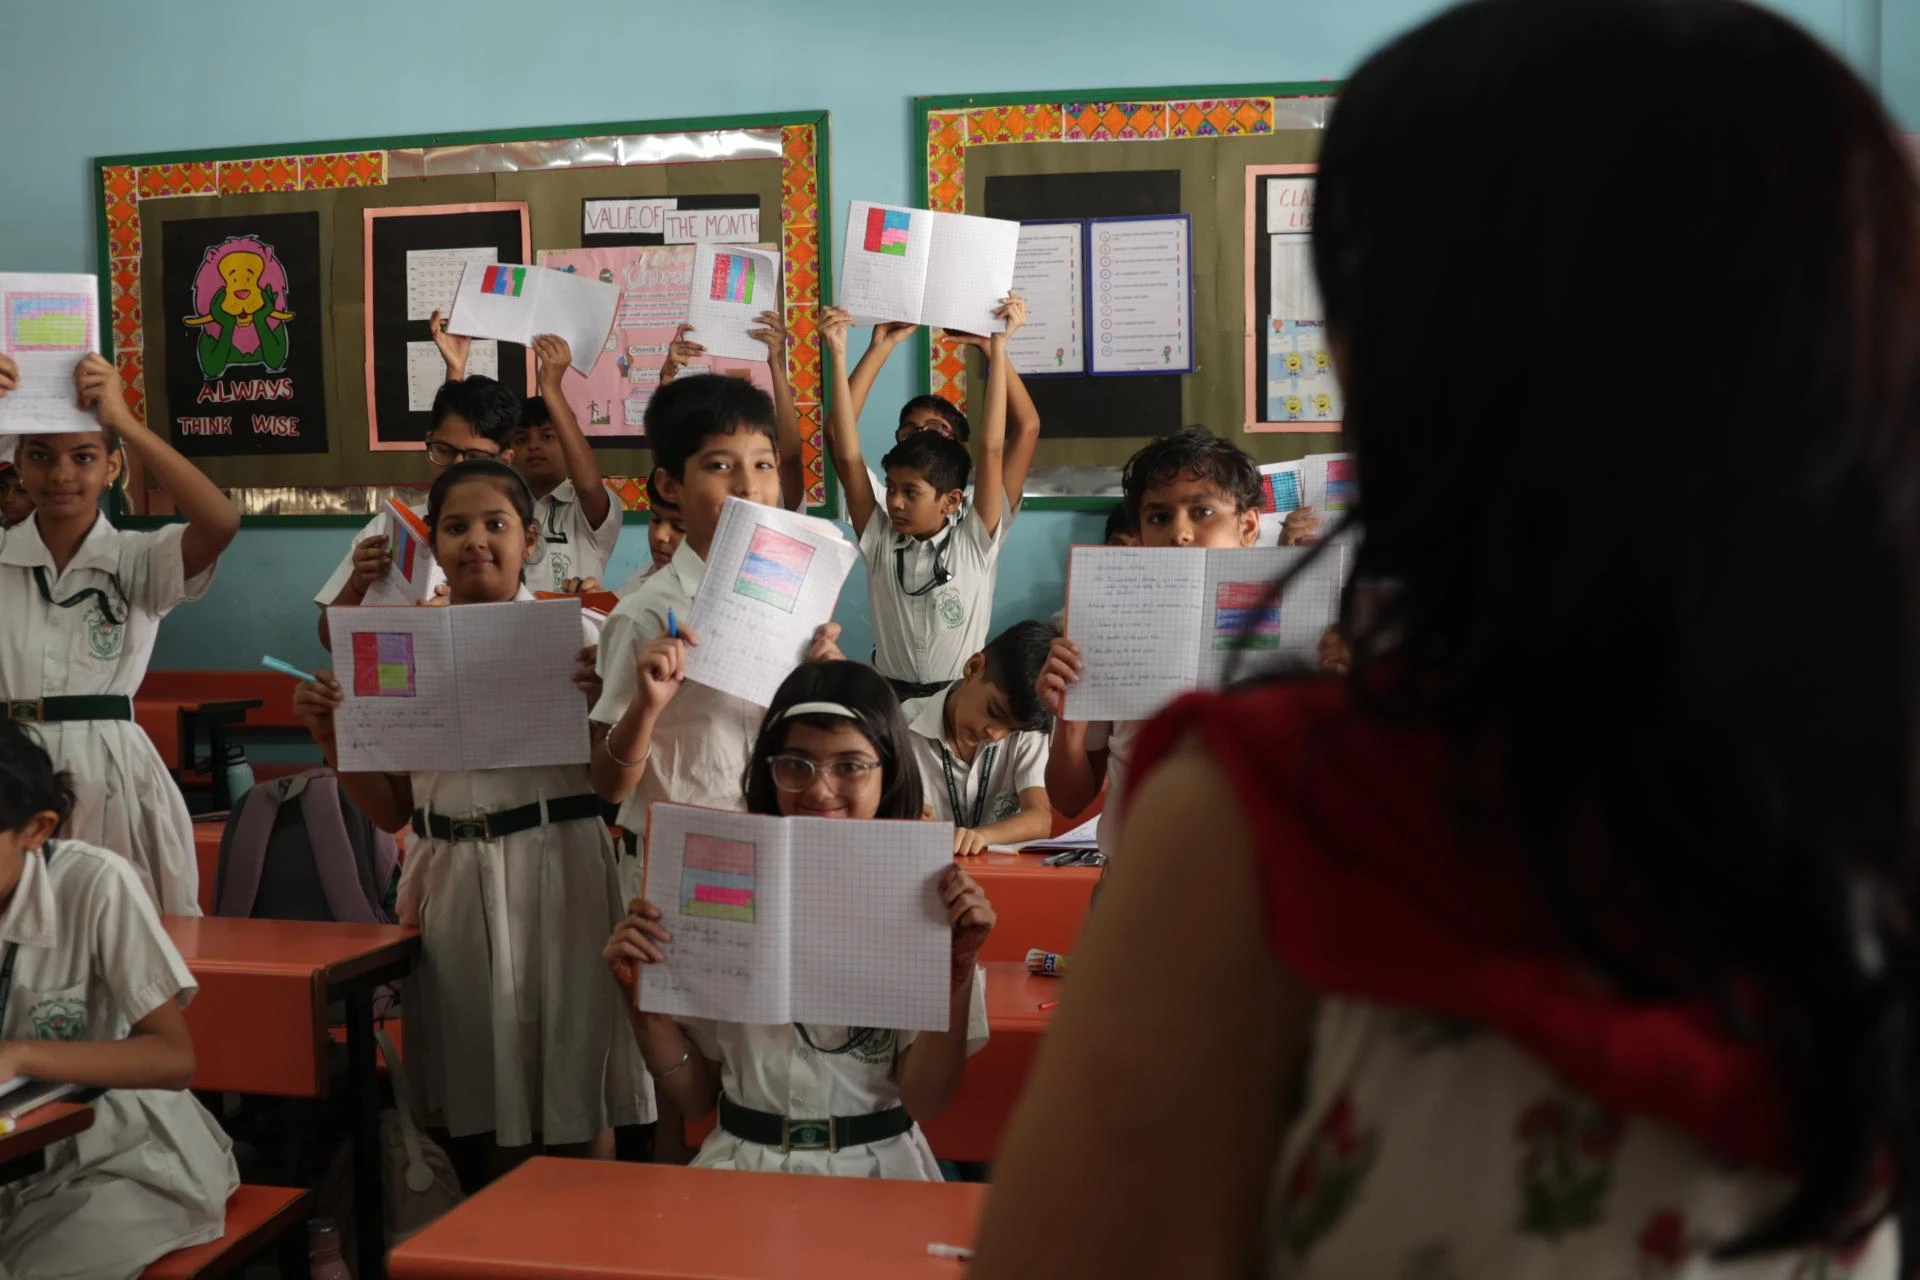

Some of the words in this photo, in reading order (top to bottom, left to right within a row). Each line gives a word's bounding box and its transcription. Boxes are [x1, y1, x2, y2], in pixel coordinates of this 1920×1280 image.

[1280, 188, 1314, 208] CLA
[586, 207, 636, 230] VALUE
[639, 205, 665, 230] OF
[666, 215, 698, 239] THE
[705, 213, 760, 238] MONTH
[1289, 212, 1313, 228] LIS
[197, 378, 294, 404] ALWAYS
[177, 416, 233, 436] THINK
[252, 414, 300, 437] WISE
